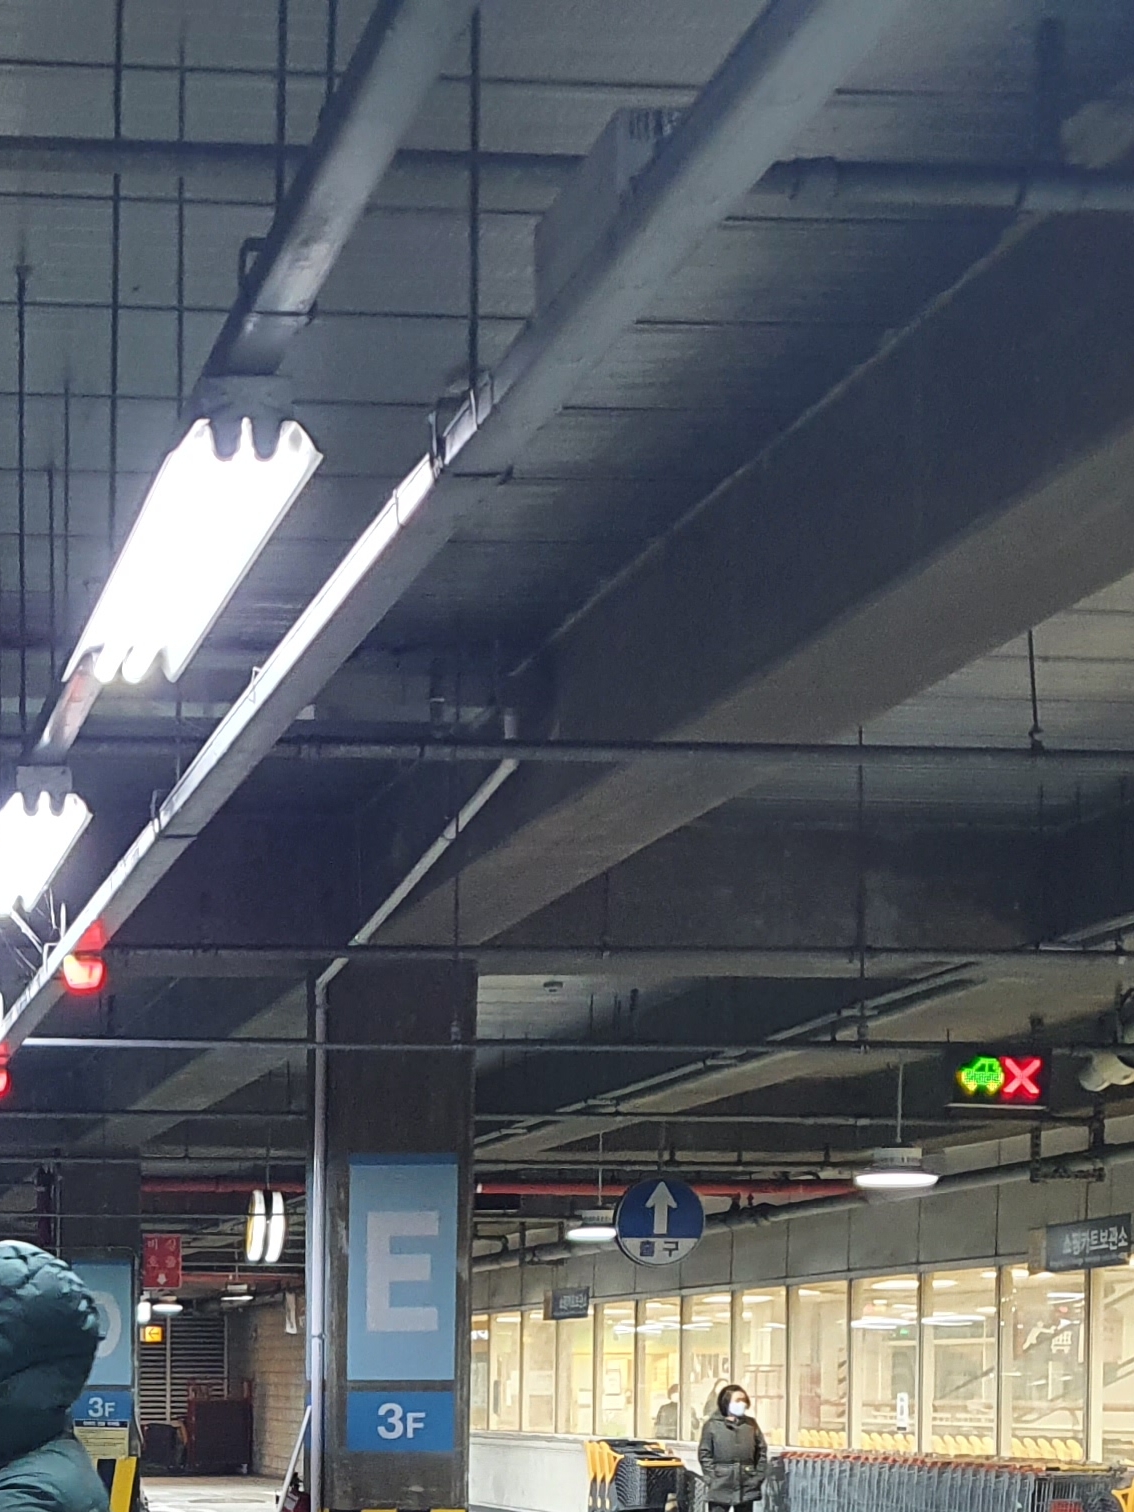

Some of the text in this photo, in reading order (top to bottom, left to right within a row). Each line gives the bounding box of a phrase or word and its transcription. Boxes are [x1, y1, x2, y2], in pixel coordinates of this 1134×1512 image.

[367, 1211, 439, 1332] E
[88, 1396, 116, 1418] 3F
[377, 1403, 426, 1440] 3F
